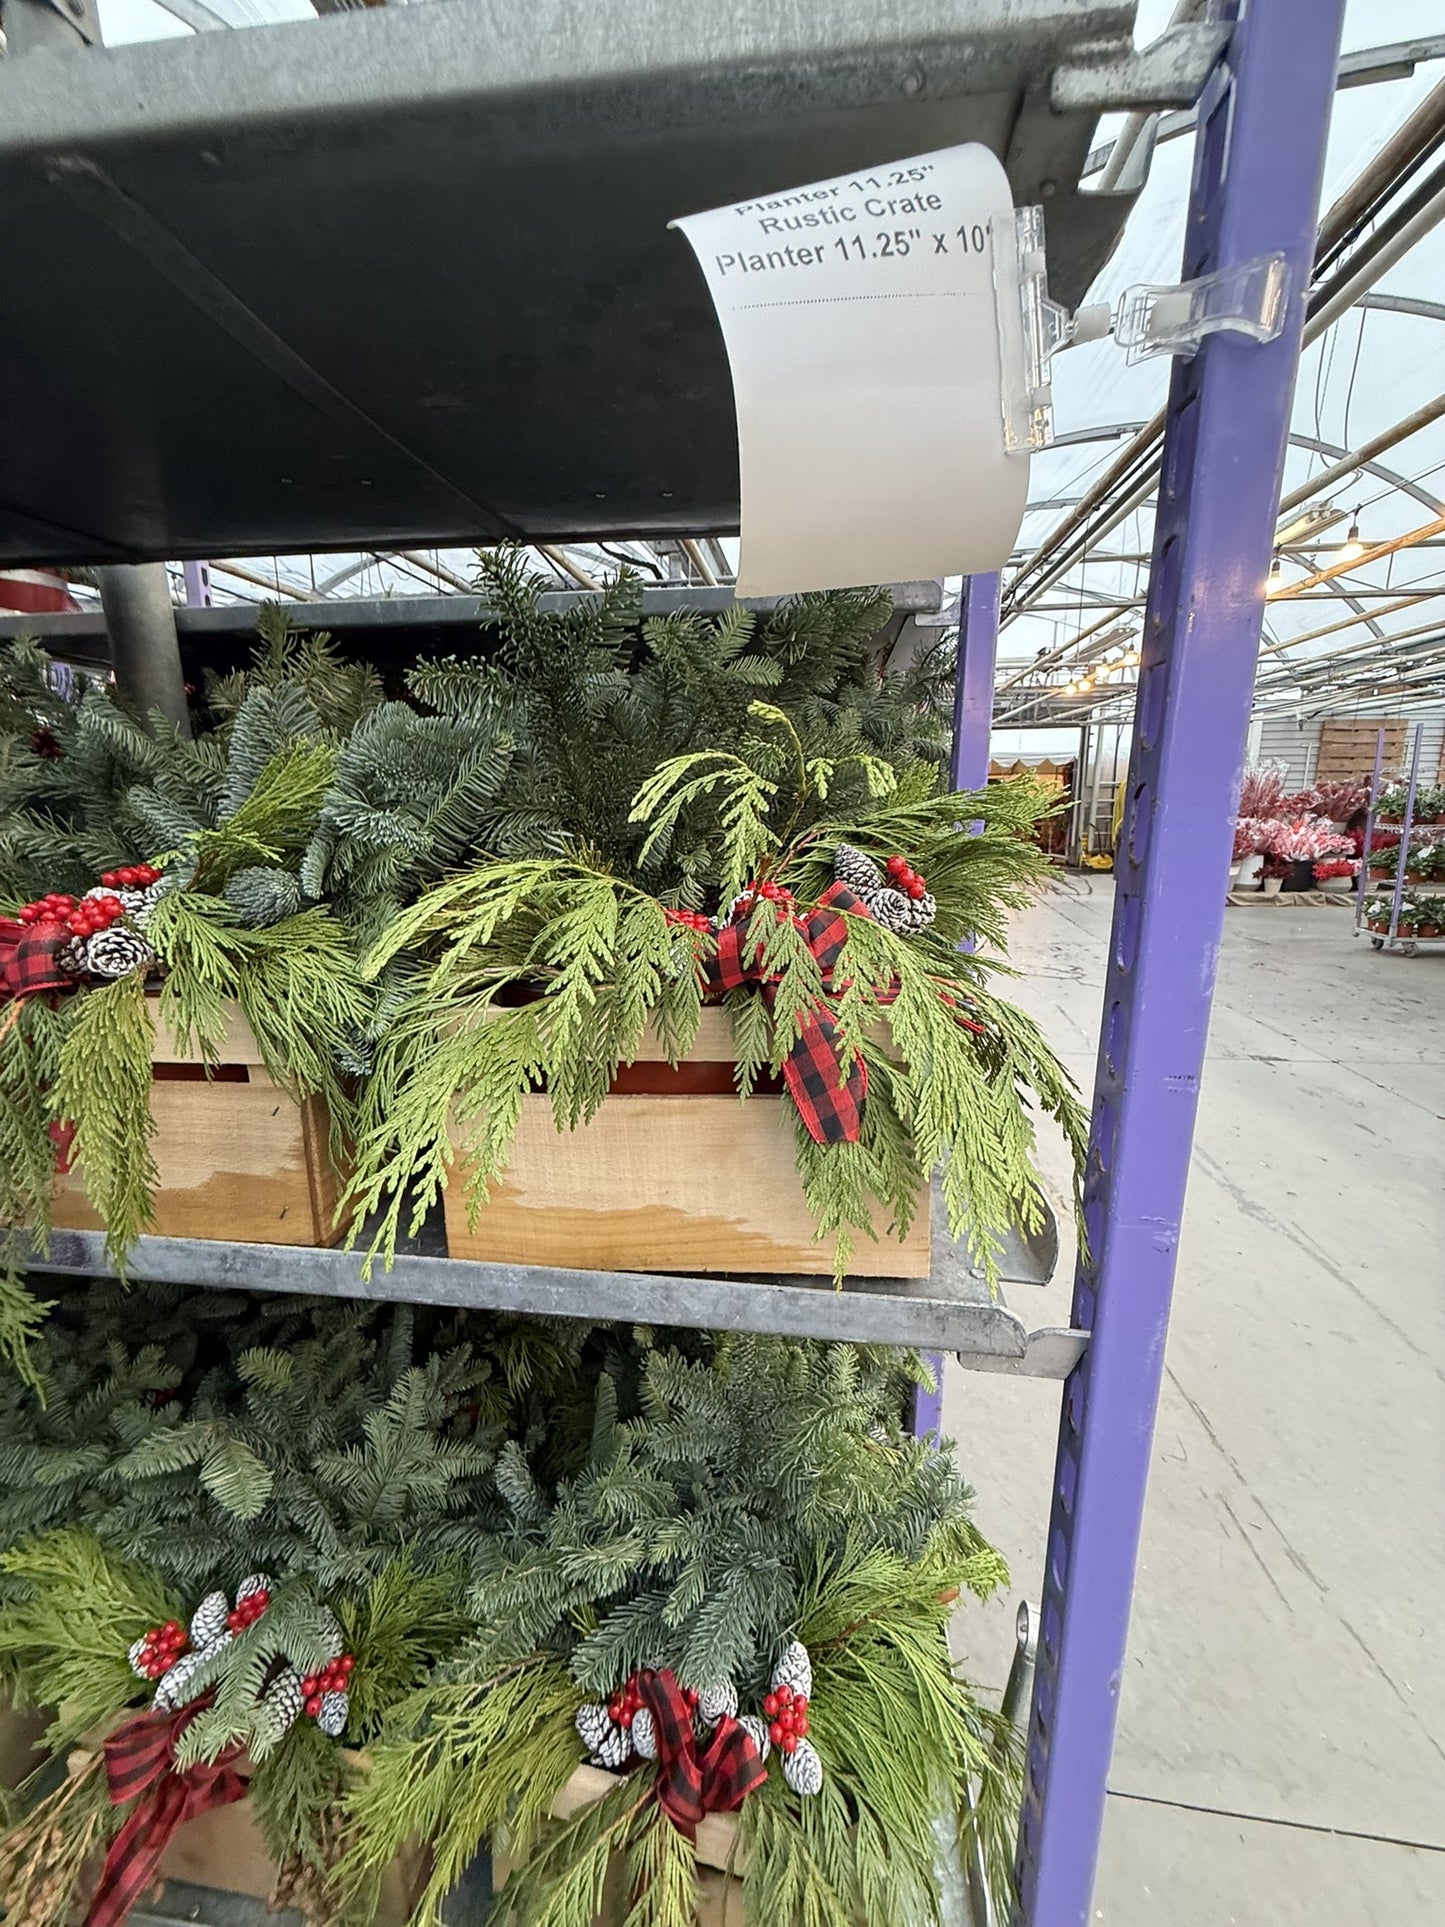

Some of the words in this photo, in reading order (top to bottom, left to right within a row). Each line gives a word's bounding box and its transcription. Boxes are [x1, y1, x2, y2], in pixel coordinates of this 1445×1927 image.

[734, 187, 840, 216] Planter
[848, 164, 935, 192] 11.25"
[758, 206, 857, 234] Rustic
[864, 193, 943, 217] Crate
[715, 244, 825, 276] Planter
[834, 228, 921, 261] 11.25"
[932, 233, 949, 254] x
